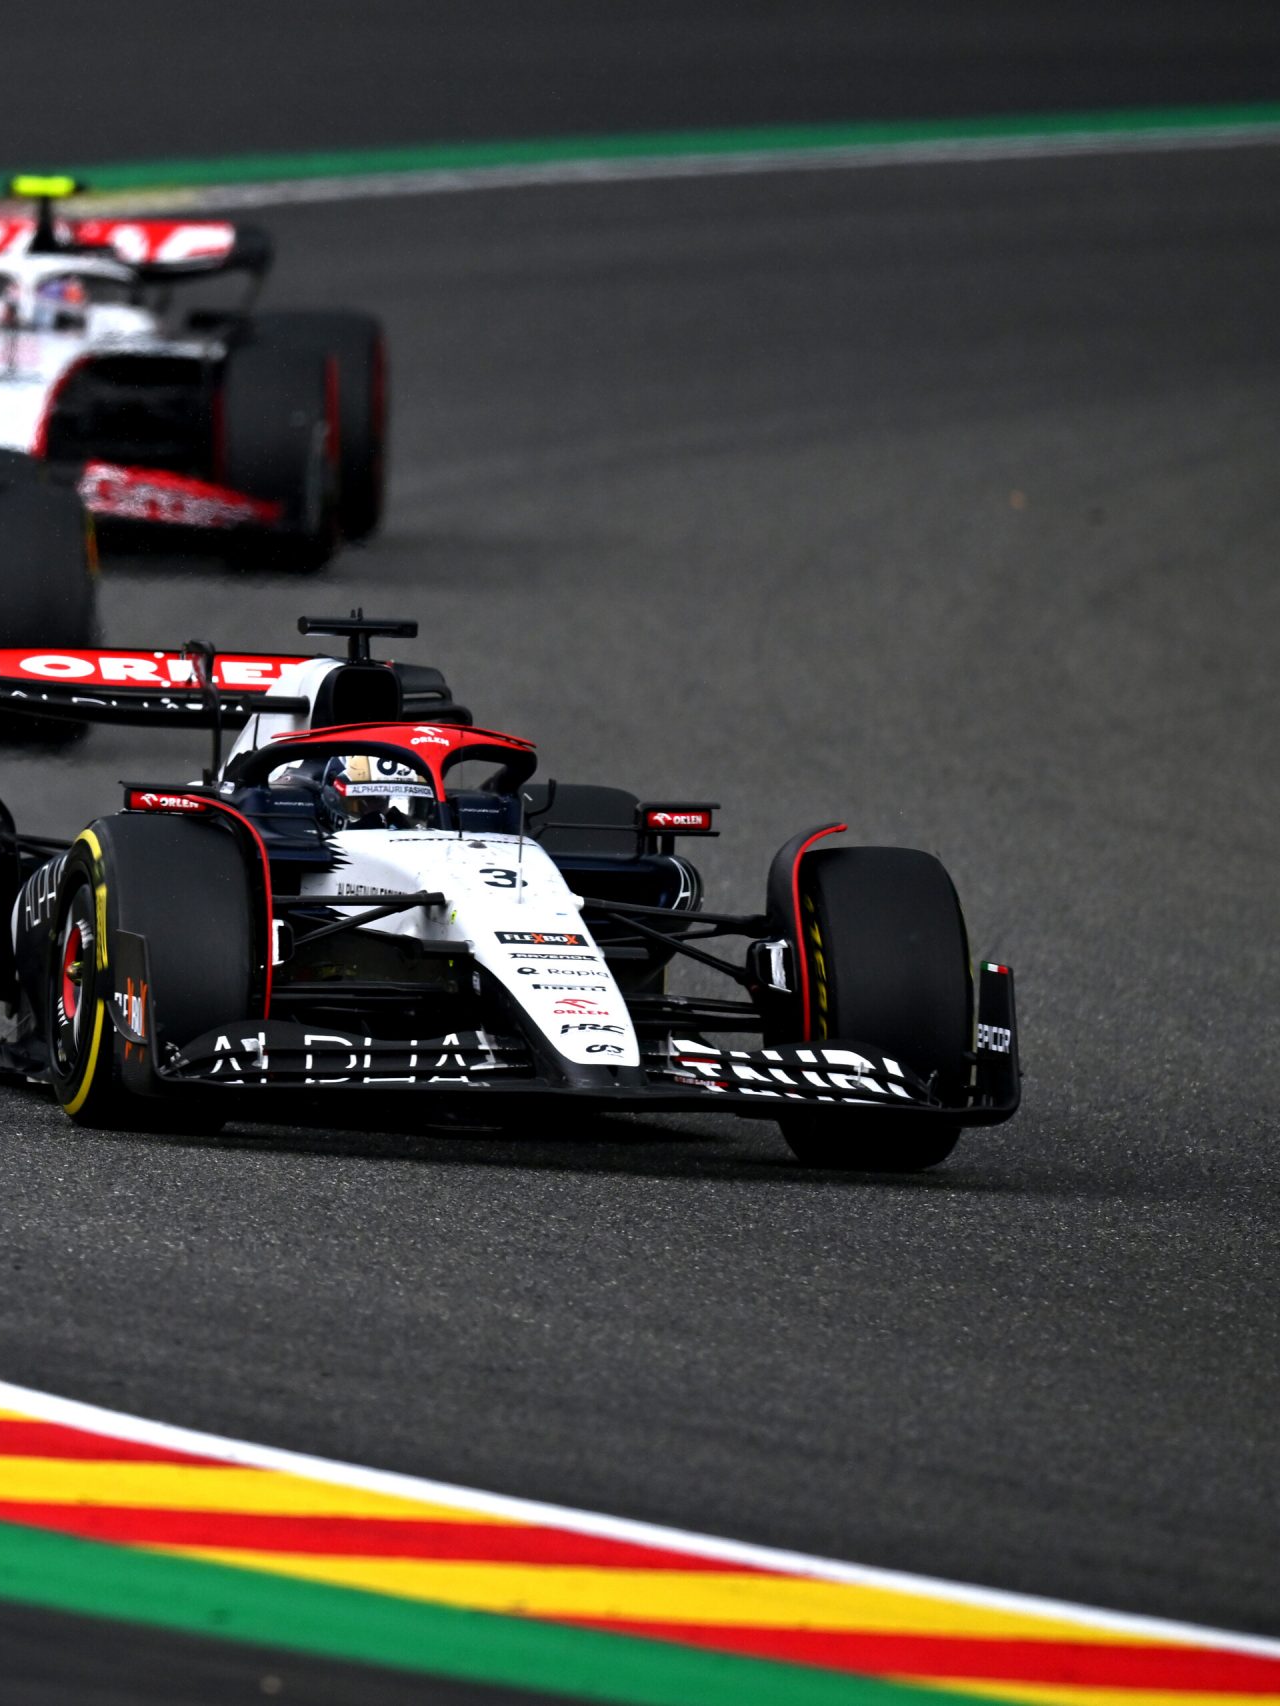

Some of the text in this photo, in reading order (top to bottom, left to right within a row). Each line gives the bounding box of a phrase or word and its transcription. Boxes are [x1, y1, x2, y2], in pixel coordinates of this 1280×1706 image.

[410, 735, 449, 747] ORLEN
[160, 796, 199, 809] ORLEN
[672, 815, 703, 825] ORLEN
[479, 868, 528, 888] 3
[503, 932, 579, 944] FLEXBOX
[514, 953, 594, 961] RAVENOL
[532, 983, 607, 992] PIRELLI
[560, 1023, 626, 1035] HRC
